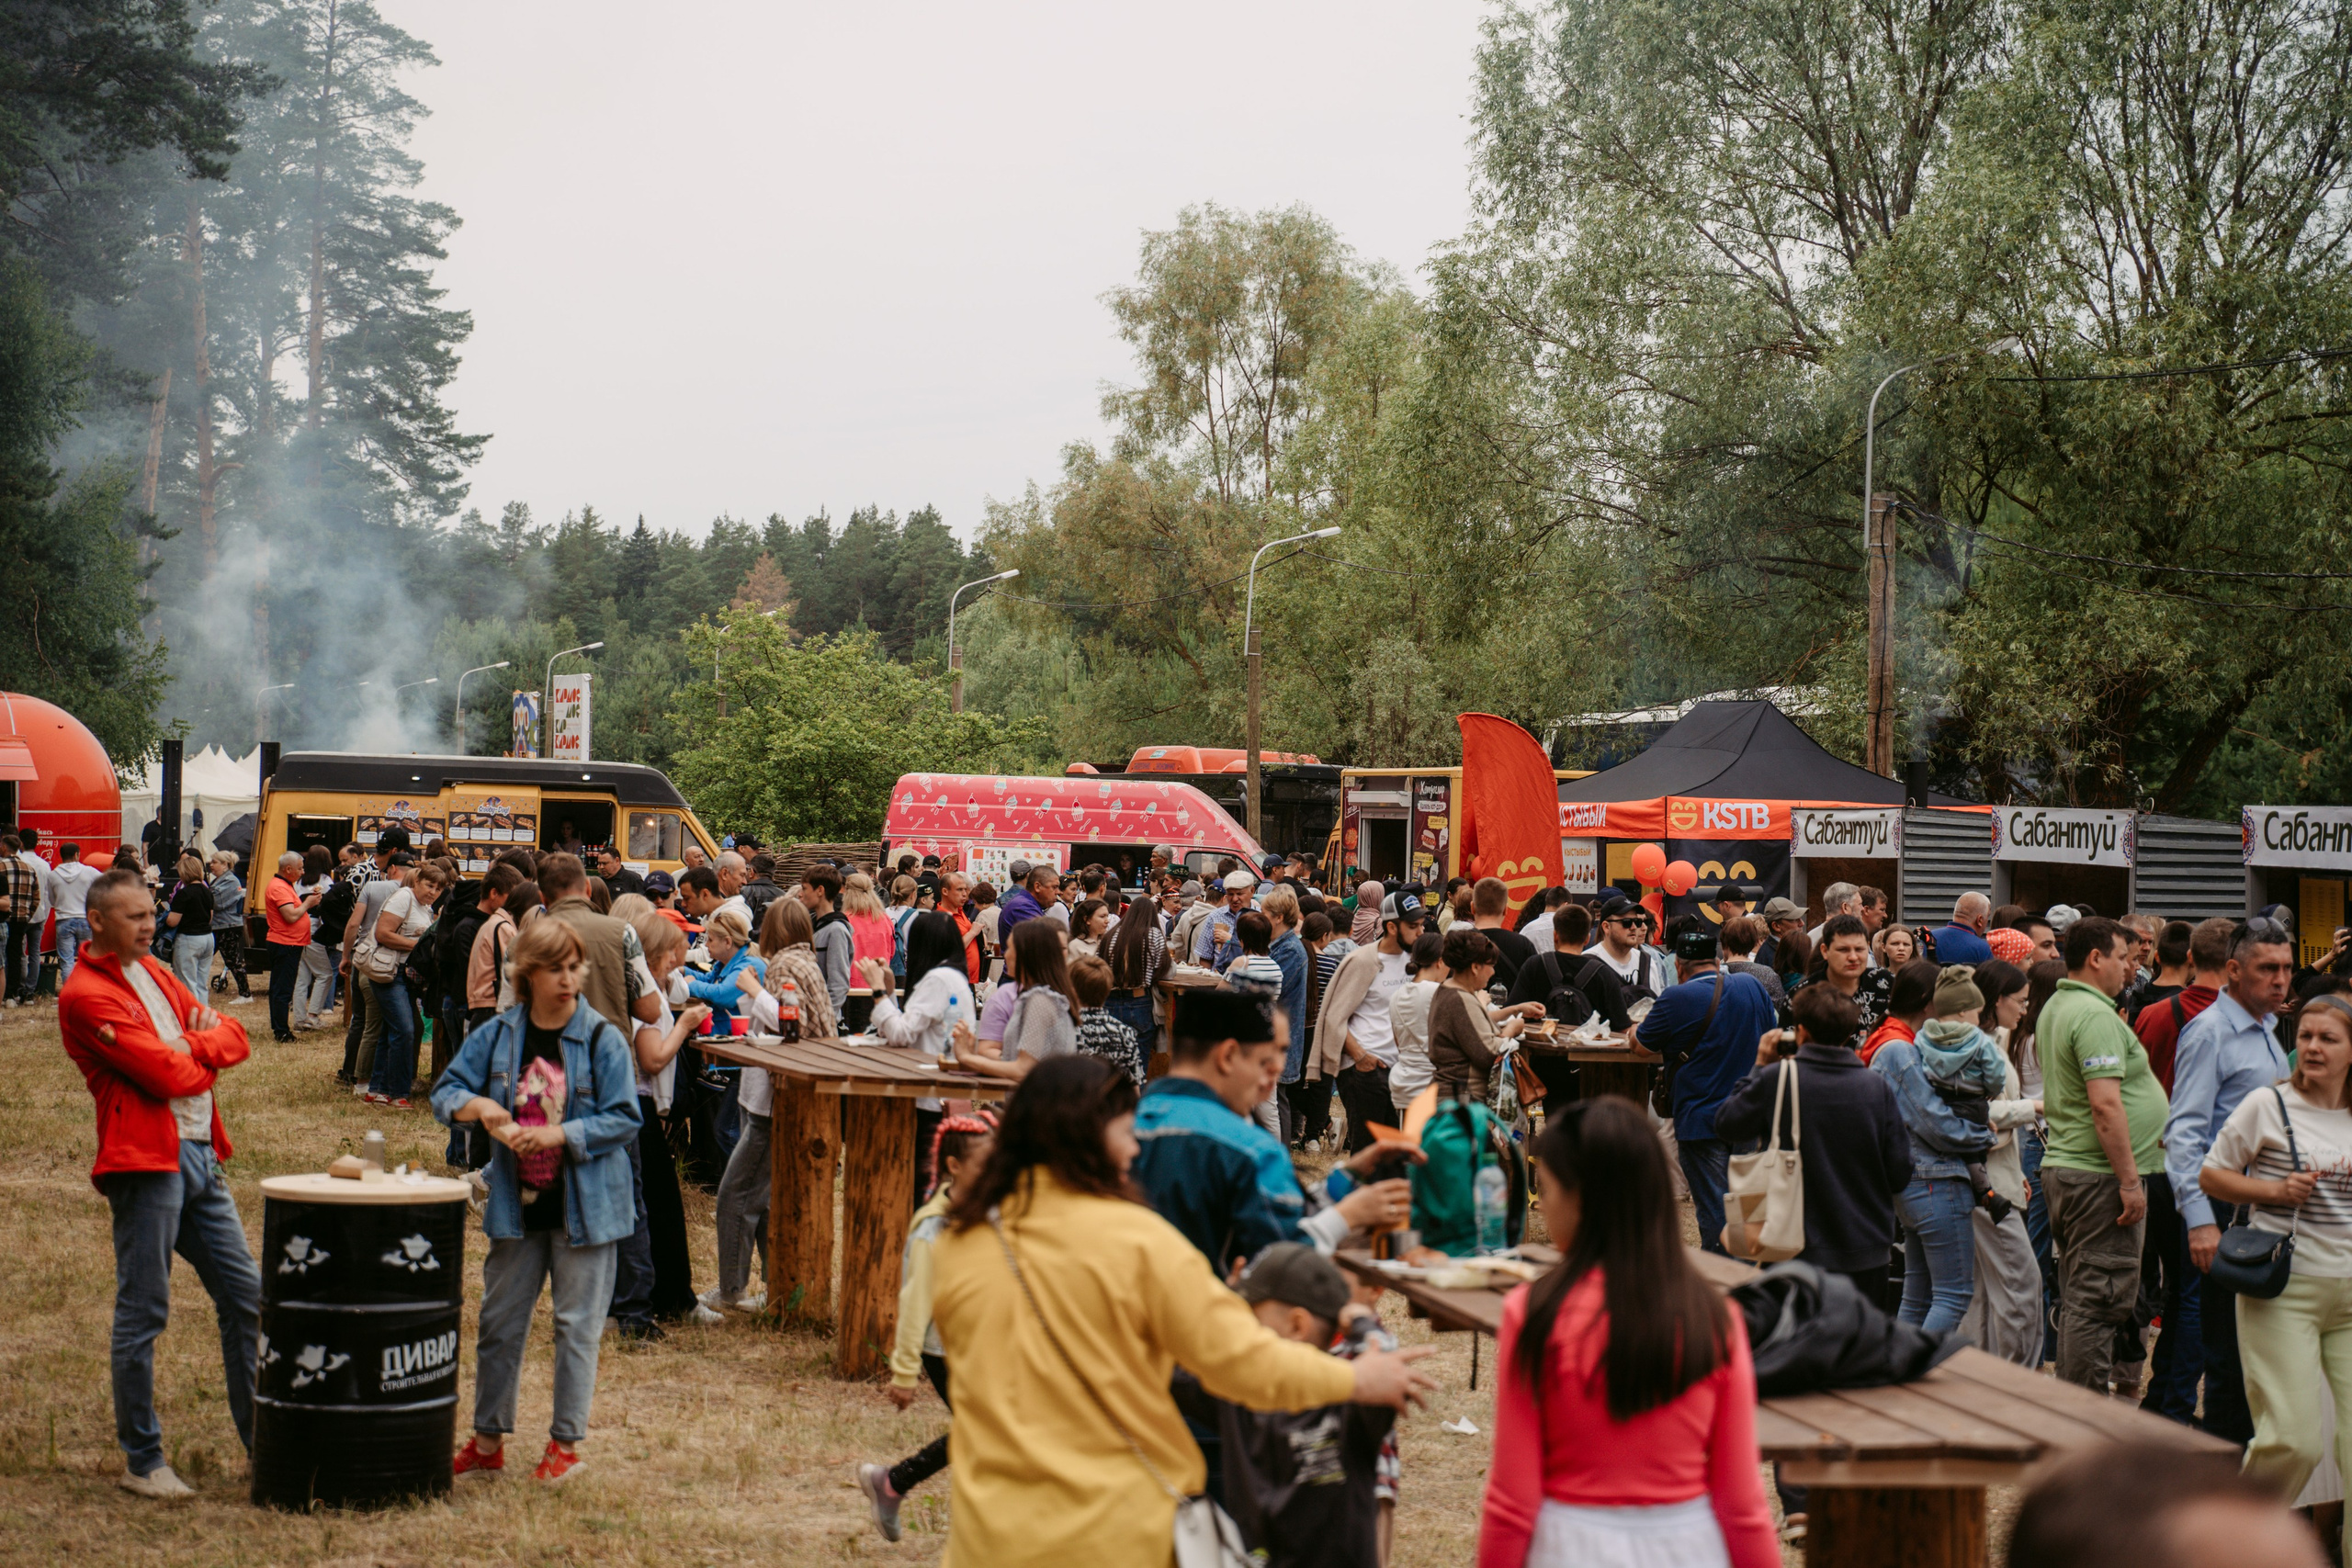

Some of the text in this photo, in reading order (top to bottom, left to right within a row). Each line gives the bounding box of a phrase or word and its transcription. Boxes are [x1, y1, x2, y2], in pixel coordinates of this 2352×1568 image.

[1703, 802, 1770, 829] KSTB
[1804, 813, 1888, 855] Сабантуй
[2009, 811, 2117, 861] Сабантуй
[381, 1330, 457, 1381] ДИВАР
